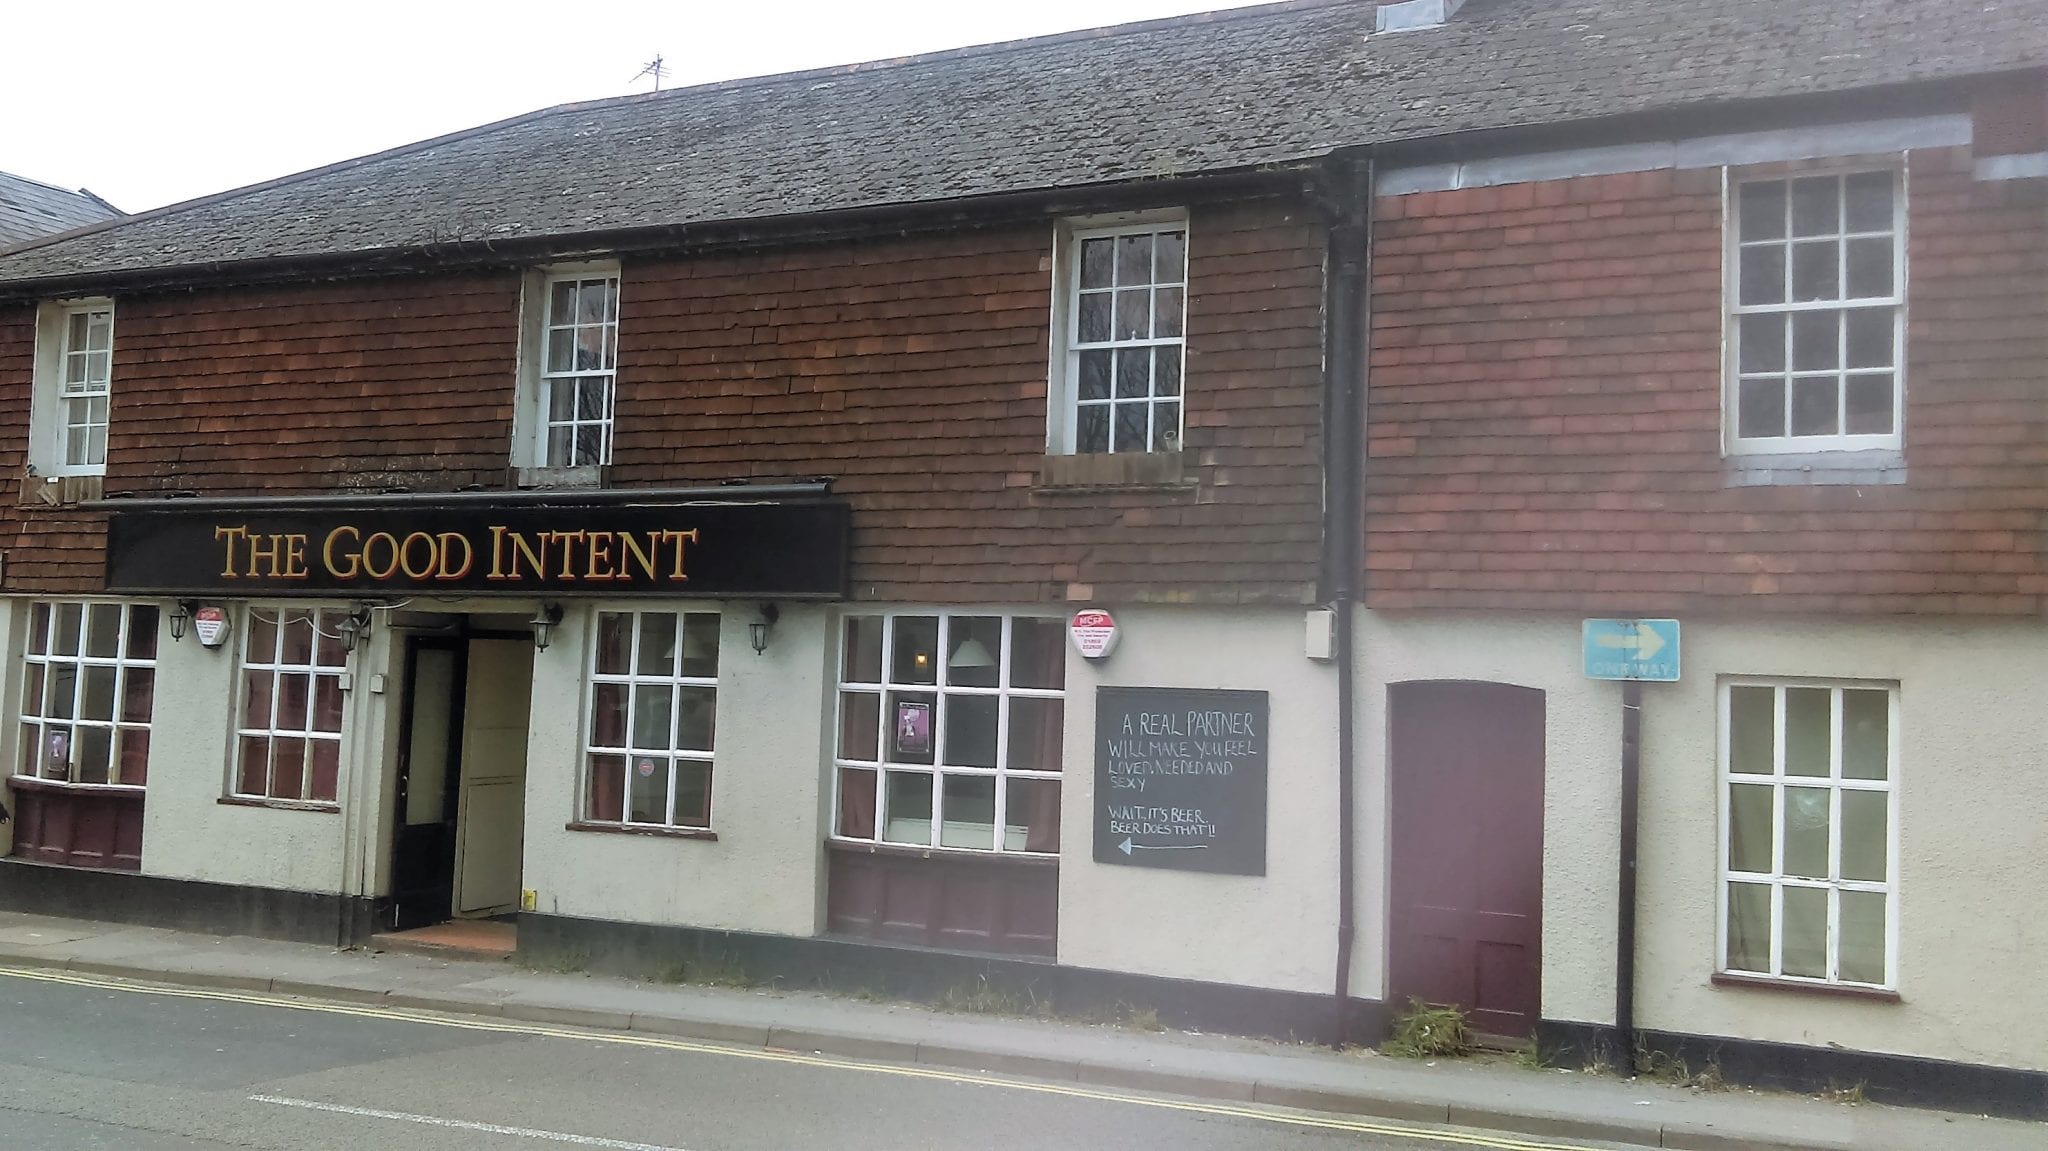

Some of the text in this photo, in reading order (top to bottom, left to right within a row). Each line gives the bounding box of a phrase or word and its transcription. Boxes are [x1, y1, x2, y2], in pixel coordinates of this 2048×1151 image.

[215, 524, 700, 582] THE GOOD INTENT
[1592, 662, 1671, 676] ONE WAY
[1122, 710, 1255, 737] A REAL PARTNER
[1108, 739, 1258, 759] WILL MAKE YOU FEEL
[1155, 759, 1204, 776] NEEDED
[1204, 761, 1233, 776] AND
[1110, 775, 1146, 792] SEXY
[1148, 806, 1168, 821] IT'S
[1110, 821, 1142, 834] BEER
[1143, 822, 1172, 834] DOES
